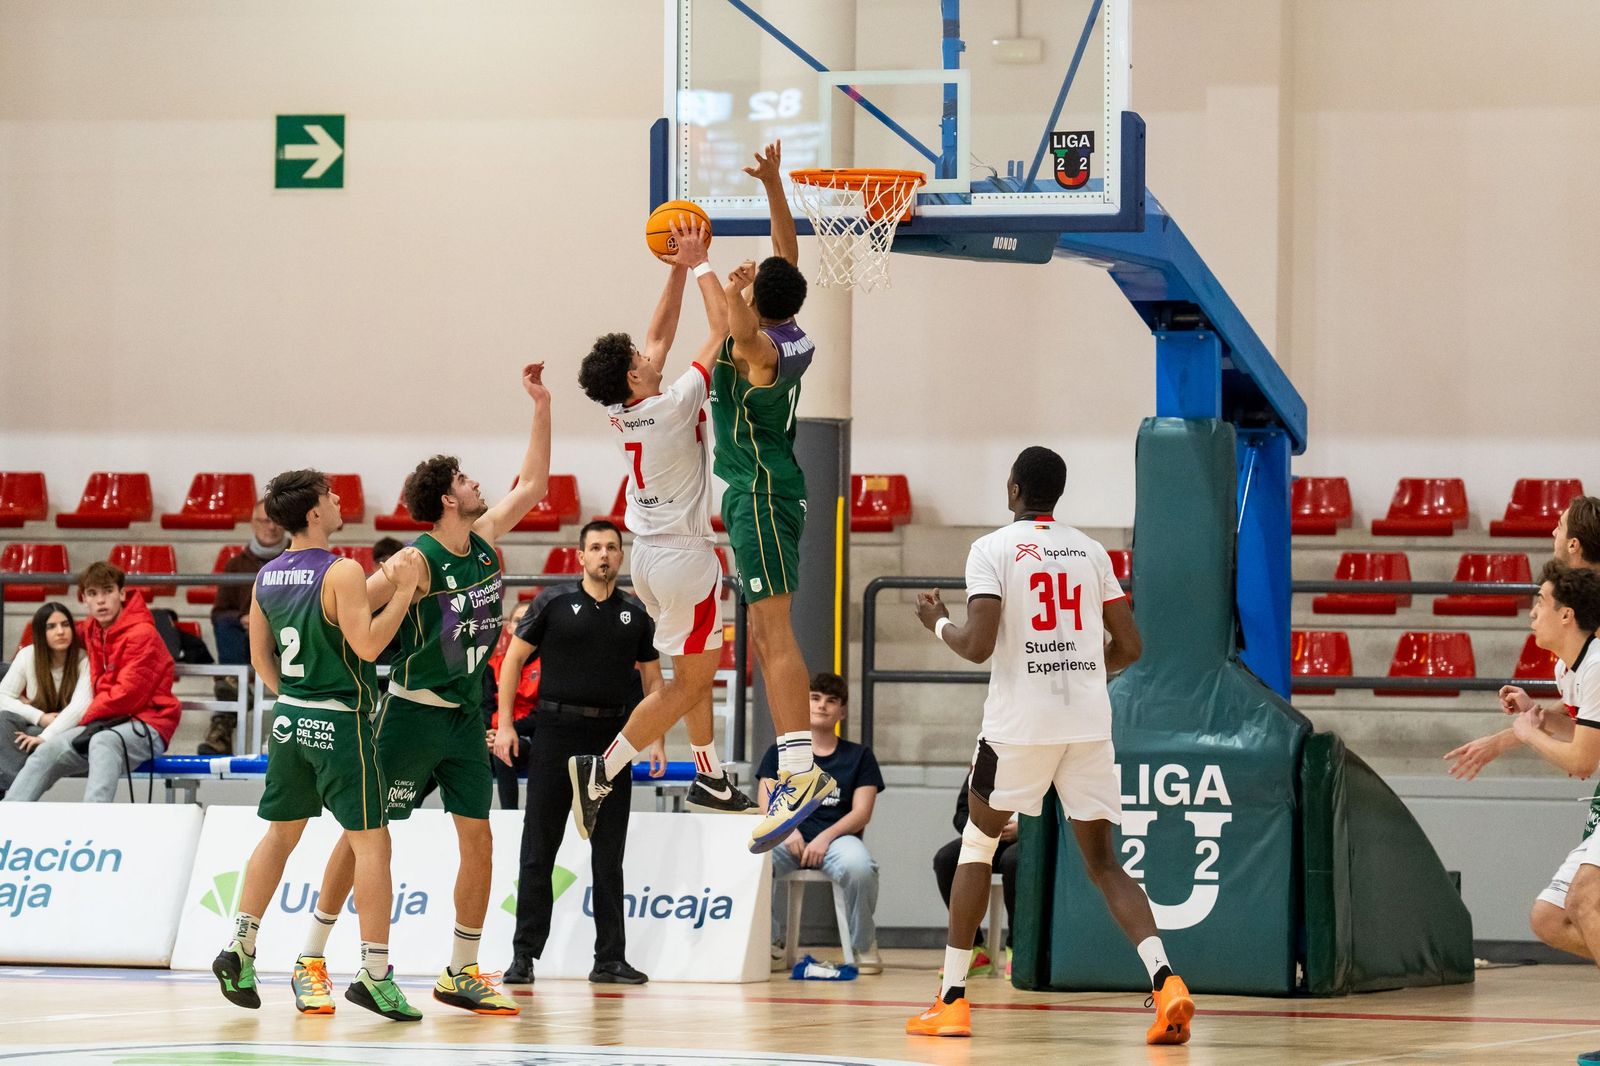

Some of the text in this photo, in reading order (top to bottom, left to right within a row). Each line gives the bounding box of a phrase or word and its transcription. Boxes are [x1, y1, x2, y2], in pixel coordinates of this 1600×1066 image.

[1053, 134, 1091, 148] LIGA
[992, 236, 1018, 251] MONDO
[623, 418, 655, 430] lapalma
[624, 441, 646, 490] 7
[1044, 547, 1086, 560] lapalma
[262, 567, 315, 586] MARTÍNEZ
[468, 579, 503, 600] Fundación
[471, 591, 500, 609] Unicaja
[1030, 572, 1083, 632] 34
[279, 626, 305, 678] 2
[1025, 639, 1077, 654] Student
[1027, 659, 1097, 675] Experience
[297, 717, 336, 732] COSTA
[296, 728, 335, 742] DEL SOL
[296, 736, 334, 750] MÁLAGA
[1114, 763, 1233, 806] LIGA
